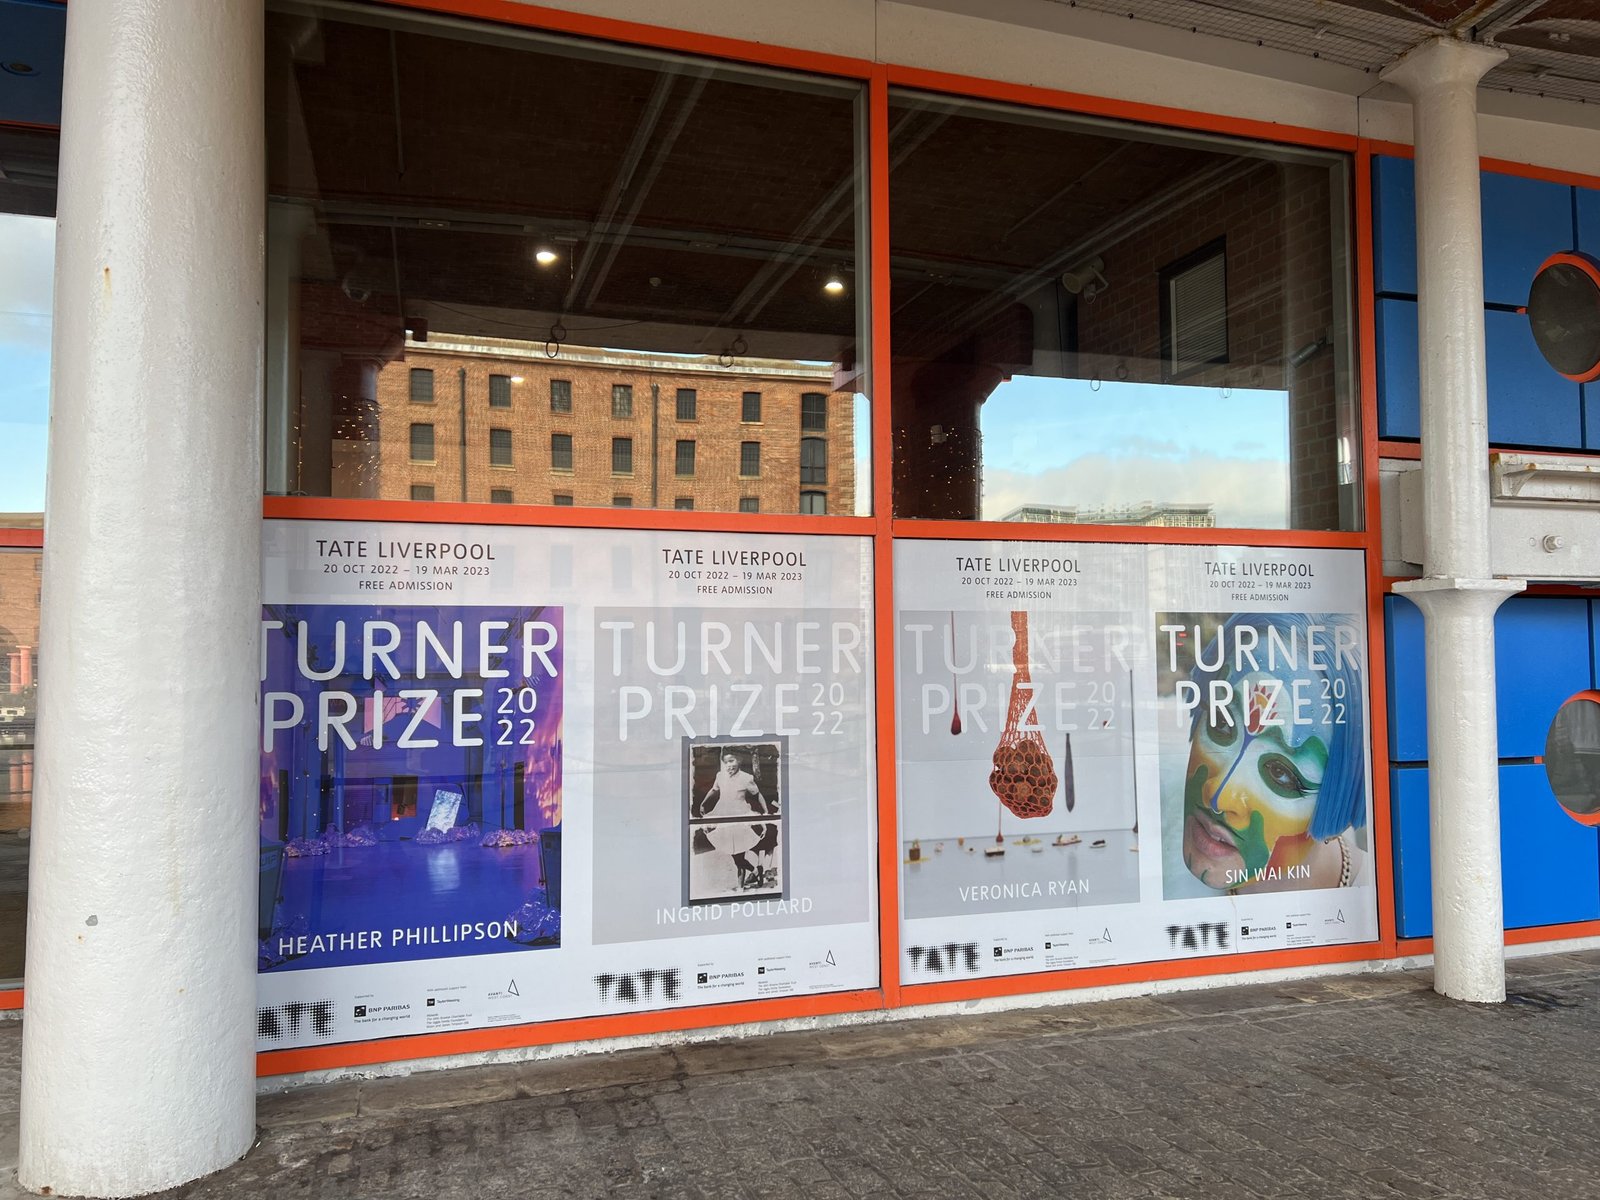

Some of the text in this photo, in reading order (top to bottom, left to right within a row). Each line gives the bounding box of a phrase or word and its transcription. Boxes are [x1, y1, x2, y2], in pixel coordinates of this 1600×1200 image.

[316, 540, 495, 560] TATE LIVERPOOL
[662, 549, 807, 567] TATE LIVERPOOL
[324, 564, 338, 573] 20
[343, 564, 364, 574] OCT
[371, 565, 398, 574] 2022
[416, 565, 427, 575] 19
[433, 565, 458, 575] MAR
[463, 566, 490, 576] 2023
[668, 570, 680, 578] 20
[684, 571, 702, 579] OCT
[706, 571, 729, 579] 2022
[742, 572, 752, 580] 19
[756, 572, 777, 580] MAR
[781, 572, 803, 580] 2023
[956, 557, 1080, 573] TATE LIVERPOOL
[1205, 562, 1314, 576] TATE LIVERPOOL
[359, 581, 452, 590] FREE ADMISSION
[697, 585, 773, 594] FREE ADMISSION
[962, 577, 972, 585] 20
[1025, 578, 1034, 586] 19
[1037, 578, 1055, 586] MAR
[1007, 591, 1052, 599] ADMISSION
[600, 621, 861, 676] TURNER
[904, 624, 1132, 674] TURNER
[1160, 625, 1358, 672] TURNER
[812, 683, 844, 706] 20
[1088, 682, 1115, 703] 20
[1321, 678, 1345, 699] 20
[497, 687, 537, 714] 20
[619, 683, 800, 741] PRIZE
[922, 682, 1078, 734] PRIZE
[1176, 679, 1312, 728] PRIZE
[264, 689, 484, 752] PRIZE
[812, 711, 844, 735] 22
[1088, 708, 1115, 730] 22
[1321, 703, 1346, 725] 22
[496, 719, 536, 745] 22
[1225, 865, 1310, 884] SIN WAI KIN
[960, 879, 1089, 902] VERONICA RYAN
[656, 897, 813, 925] INGRID POLLARD
[279, 920, 518, 956] HEATHER PHILLIPSON
[1165, 921, 1229, 952] TATE
[906, 941, 980, 975] TATE
[592, 966, 684, 1005] TATE
[257, 998, 336, 1041] ATE
